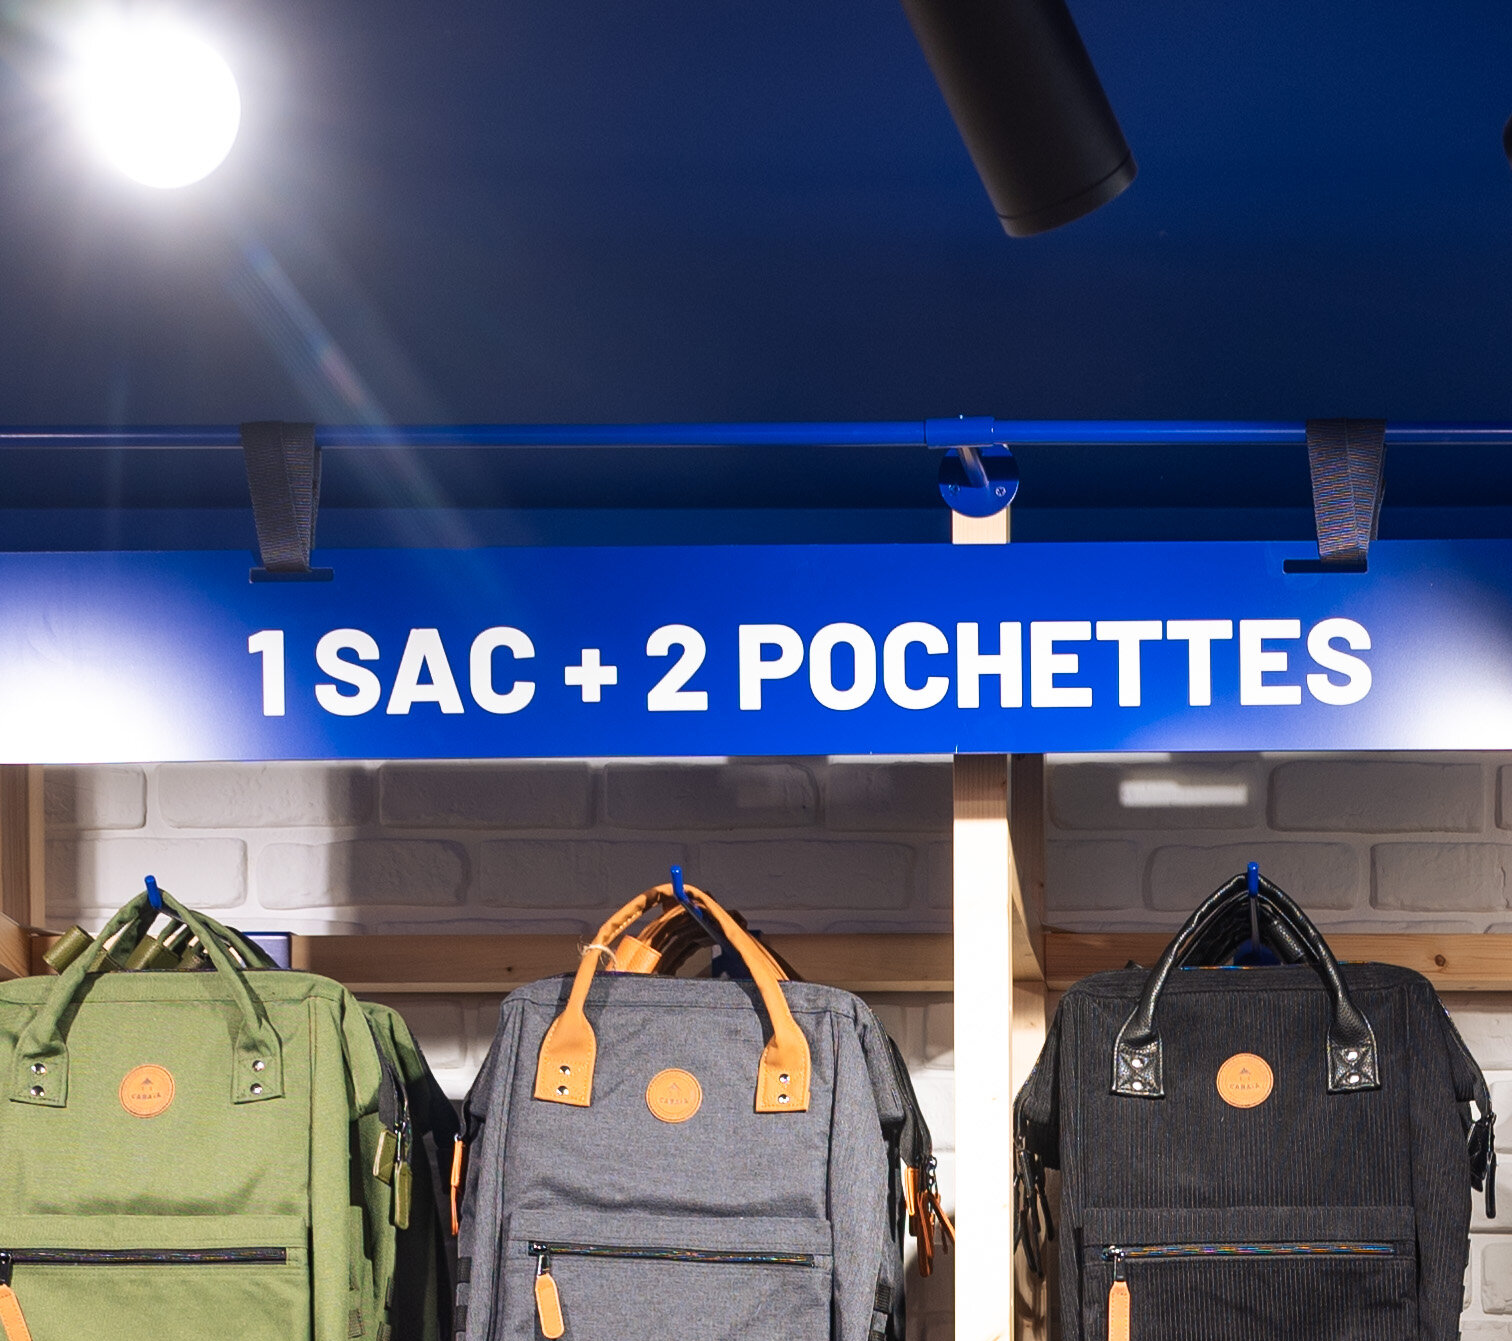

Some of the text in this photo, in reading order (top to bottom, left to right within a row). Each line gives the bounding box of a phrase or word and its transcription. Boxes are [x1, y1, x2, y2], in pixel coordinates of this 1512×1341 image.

[249, 618, 1372, 716] 1 SAC + 2 POCHETTES
